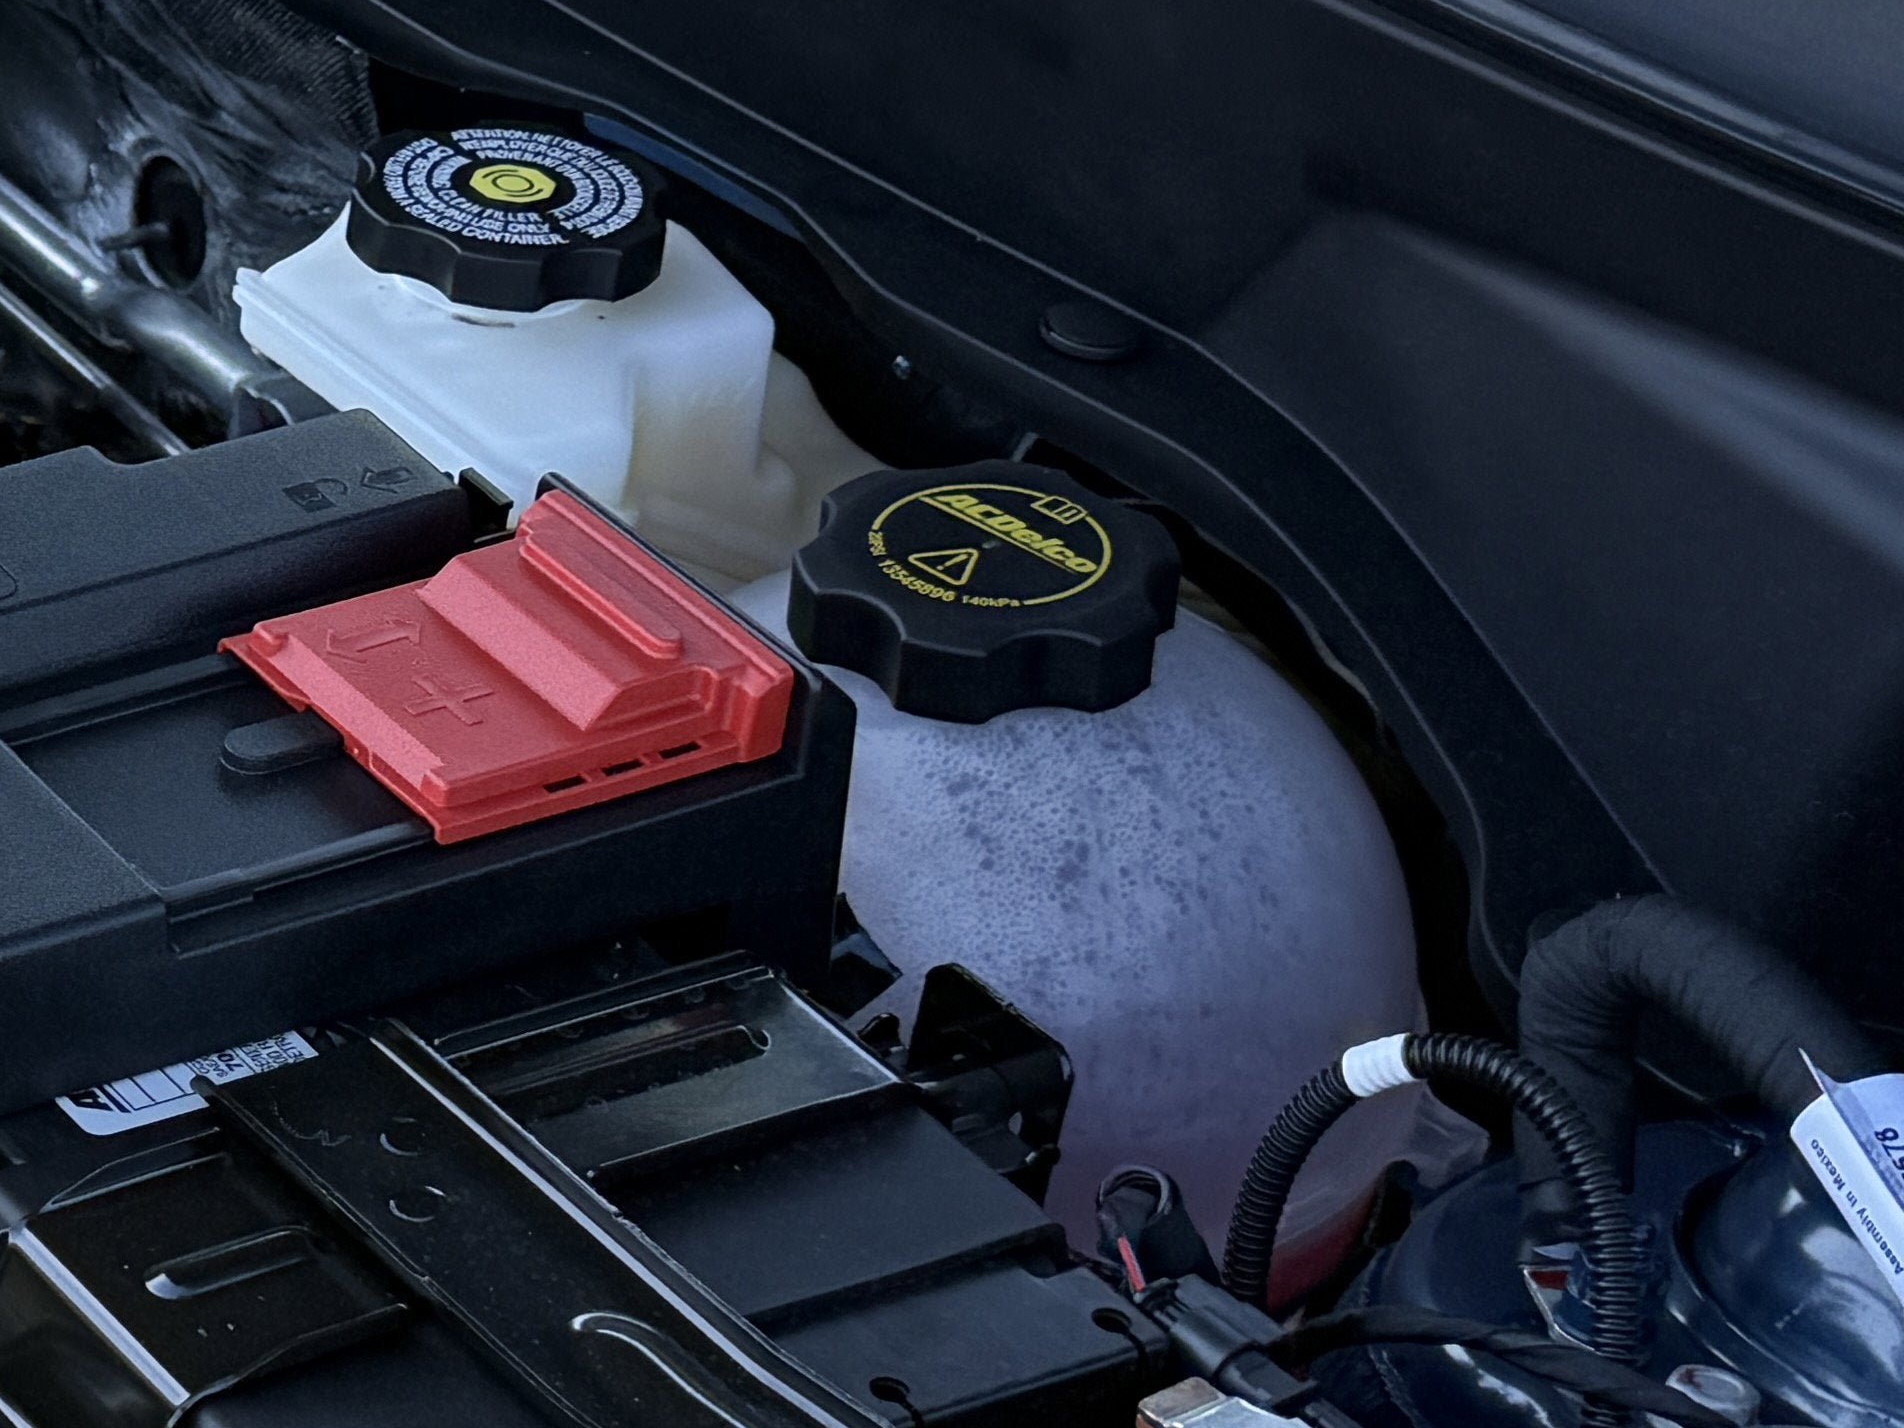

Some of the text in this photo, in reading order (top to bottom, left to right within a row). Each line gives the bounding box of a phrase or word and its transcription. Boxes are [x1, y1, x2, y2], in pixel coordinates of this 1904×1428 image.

[405, 204, 464, 232] SEALED
[470, 217, 504, 232] USE
[507, 222, 551, 234] ONLY
[481, 209, 543, 223] FILLER
[933, 494, 1099, 574] ACDelco
[1810, 1138, 1846, 1191] Mexico
[1856, 1207, 1904, 1275] Assembly
